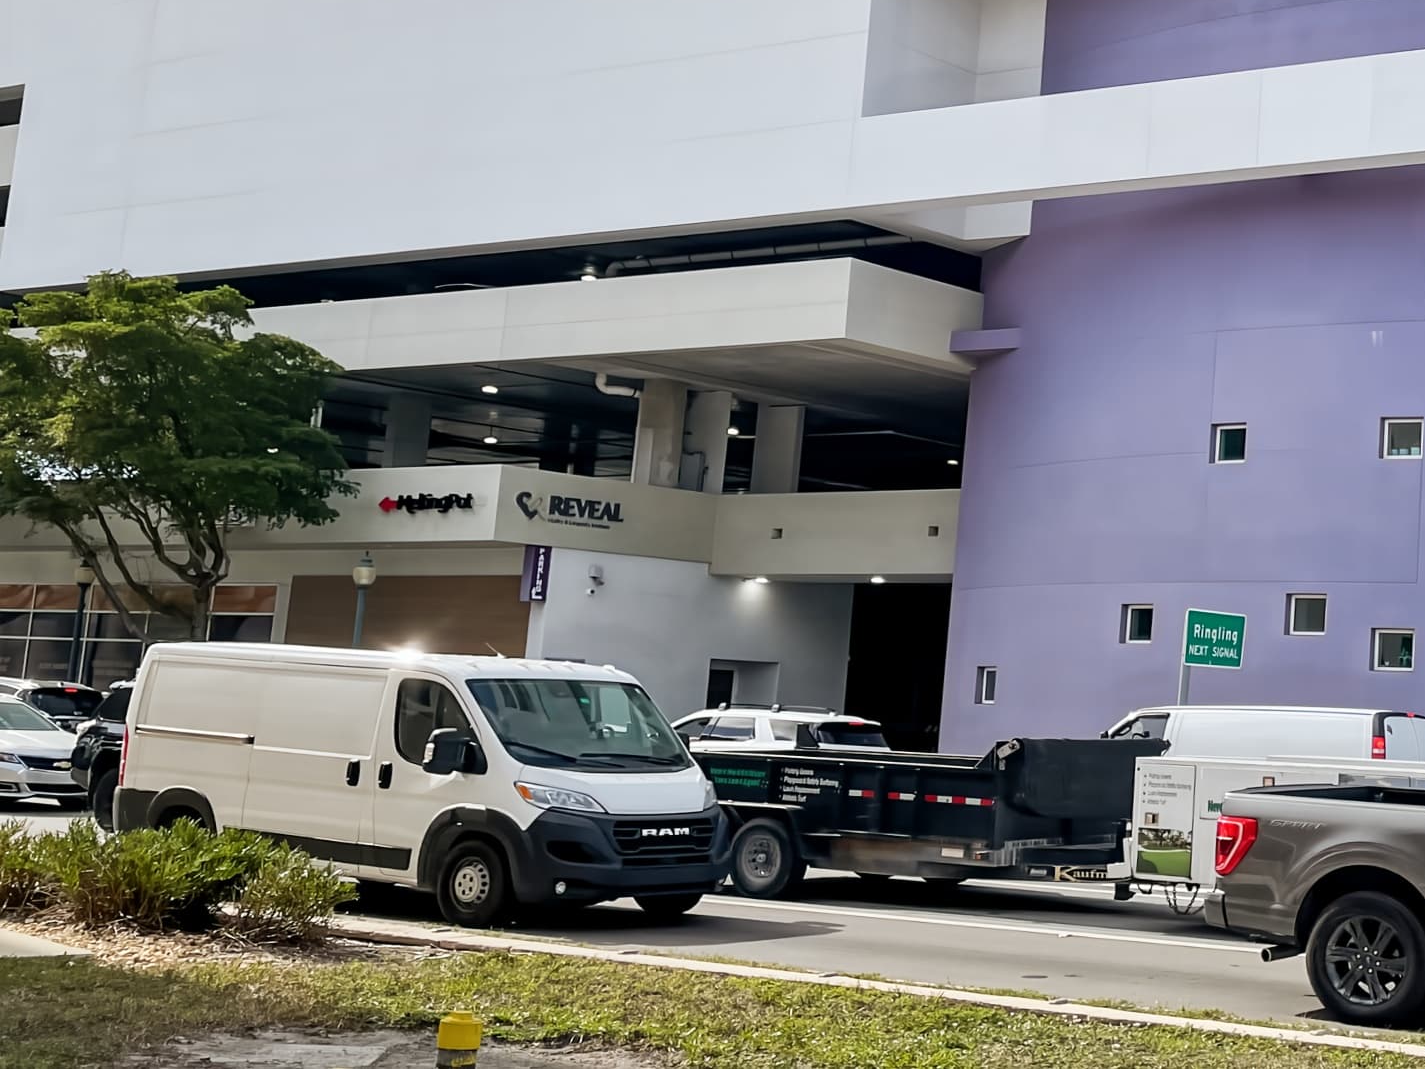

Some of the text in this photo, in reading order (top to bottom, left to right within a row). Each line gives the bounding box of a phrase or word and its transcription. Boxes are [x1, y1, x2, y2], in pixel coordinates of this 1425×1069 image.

[549, 495, 624, 522] REVEAL
[1193, 623, 1238, 645] Ringling
[1188, 644, 1239, 659] NEXT SIGNAL
[641, 827, 690, 837] RAM
